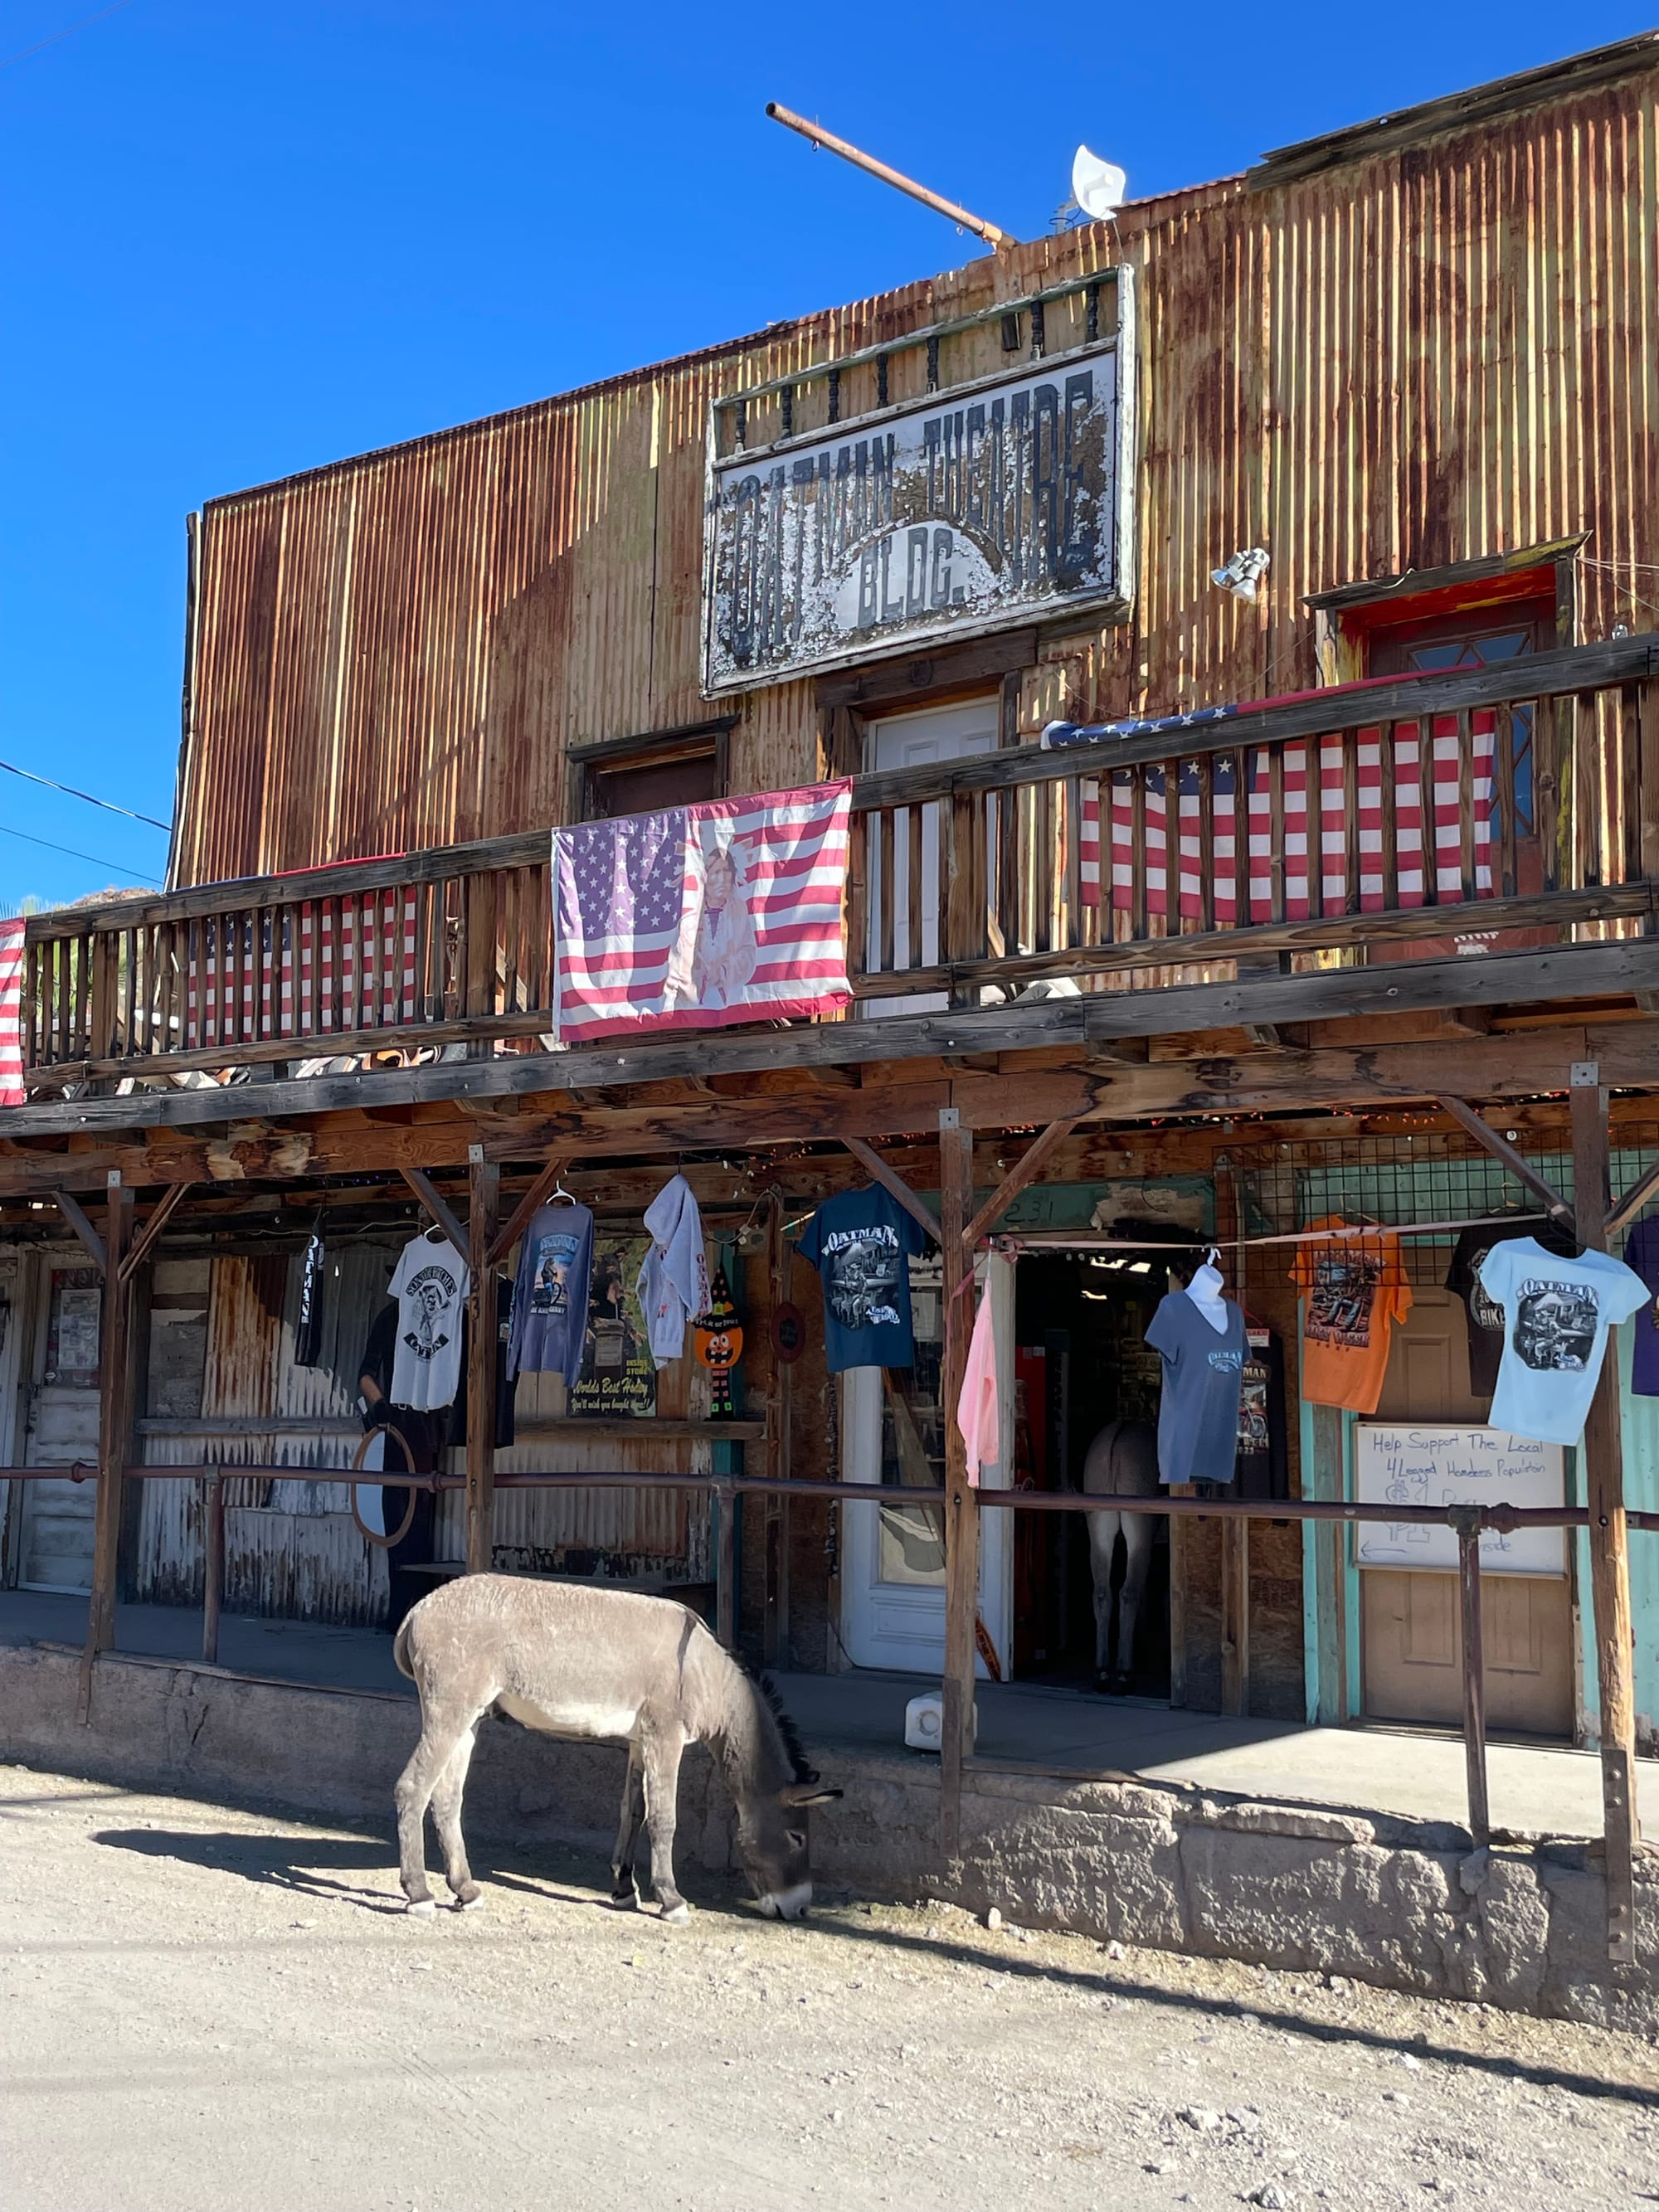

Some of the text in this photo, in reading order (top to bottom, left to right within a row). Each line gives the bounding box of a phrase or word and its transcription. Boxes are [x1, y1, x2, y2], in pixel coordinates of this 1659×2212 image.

[731, 370, 1094, 657] OATMAN THEATRE
[857, 526, 966, 629] BLDG.
[1004, 1201, 1053, 1223] 231
[828, 1225, 898, 1251] OATMAN
[1523, 1278, 1598, 1308] OATMAN
[601, 1377, 620, 1394] Best
[1374, 1432, 1544, 1456] Help Support The Local
